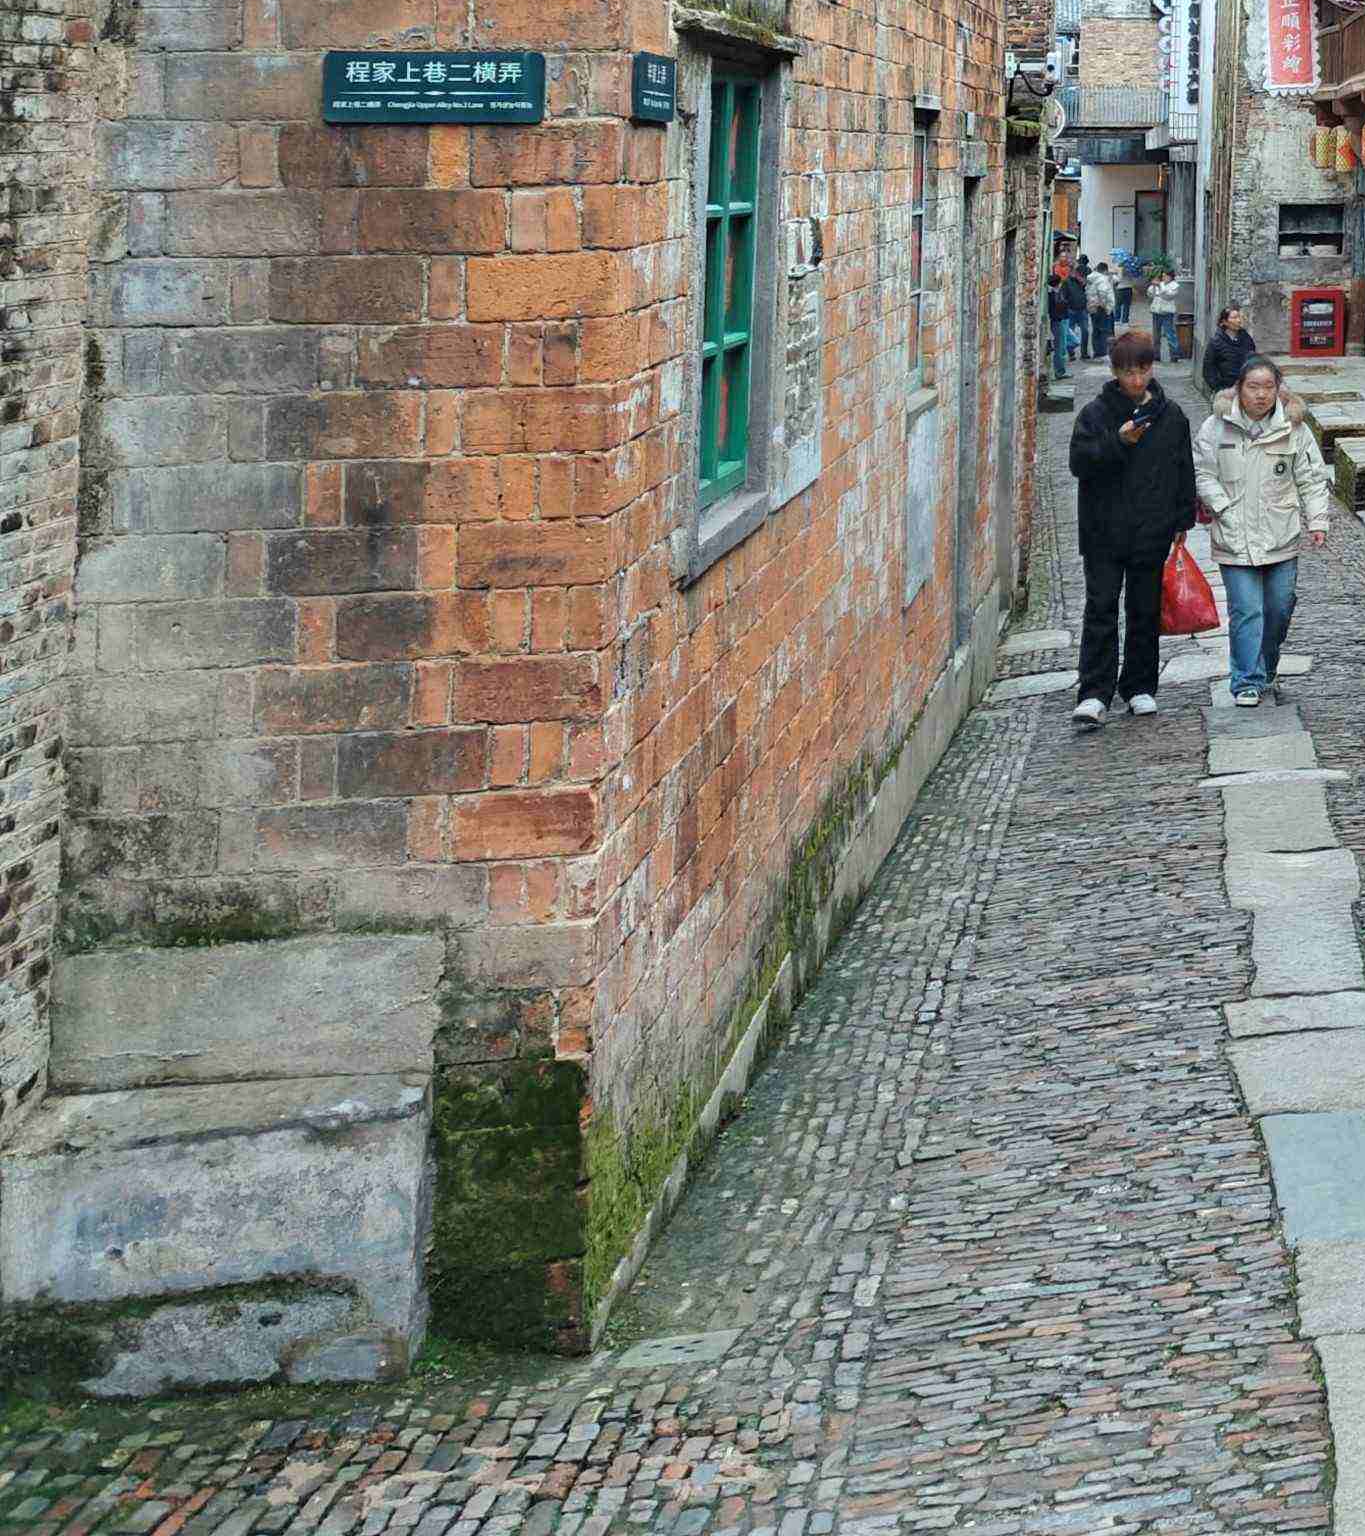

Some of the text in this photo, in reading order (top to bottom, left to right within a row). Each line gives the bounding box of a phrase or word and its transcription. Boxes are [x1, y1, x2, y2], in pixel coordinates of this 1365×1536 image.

[345, 61, 523, 85] 程家上巷二横弄
